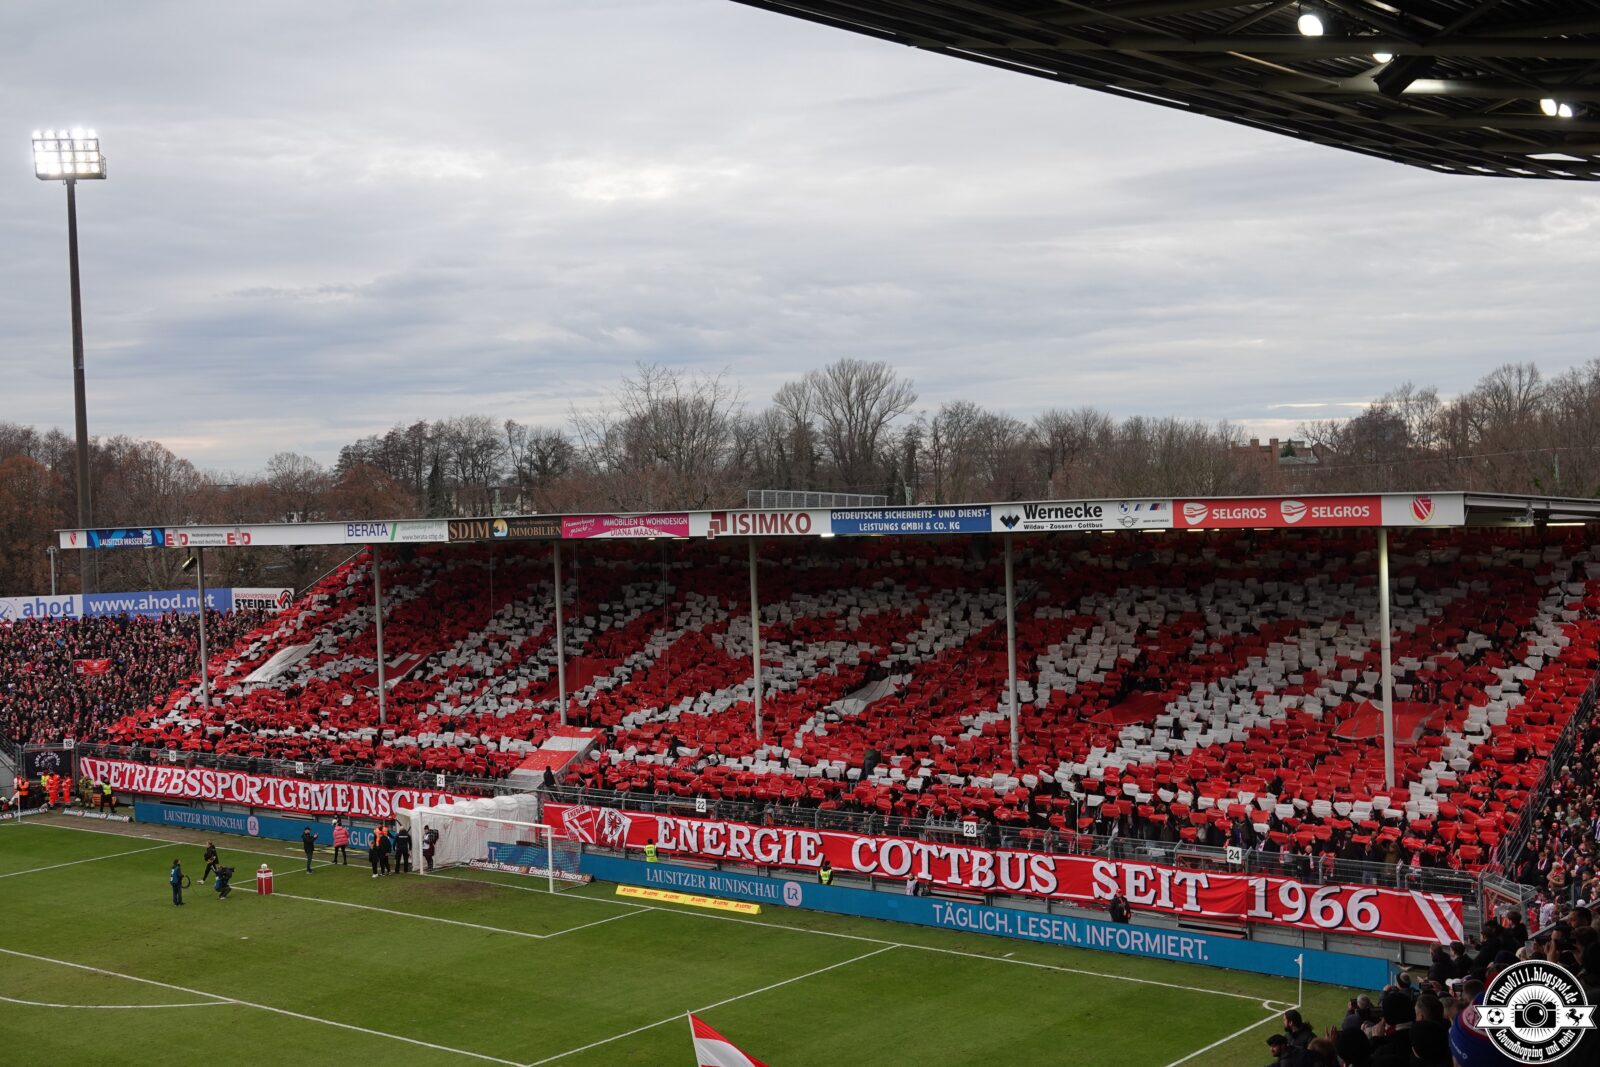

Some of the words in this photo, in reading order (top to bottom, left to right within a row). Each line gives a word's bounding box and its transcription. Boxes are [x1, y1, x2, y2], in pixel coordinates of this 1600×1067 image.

[832, 511, 883, 520] OSTDEUTSCHE
[884, 509, 936, 519] SICHERHEITS-
[938, 509, 954, 518] UND
[958, 508, 990, 518] DIENST-
[1023, 503, 1103, 520] Wernecke
[1212, 507, 1267, 520] SELGROS
[1311, 505, 1370, 518] SELGROS
[603, 517, 638, 526] IMMOBILIEN
[640, 517, 645, 525] &
[646, 516, 688, 526] WOHNDESIGN
[732, 512, 812, 534] ISIMKO
[859, 522, 899, 531] LEISTUNGS
[901, 522, 923, 531] GMBH
[926, 522, 931, 530] &
[934, 522, 947, 530] CO.
[949, 521, 960, 530] KG
[347, 523, 388, 537] BERATA
[450, 522, 490, 540] SDIM
[509, 527, 562, 537] IMMOBILIEN
[610, 527, 632, 536] DIANA
[633, 526, 662, 536] MAASCH
[99, 538, 124, 546] LAUSITZER
[22, 596, 75, 617] ahod
[235, 599, 278, 609] STEIDEL
[95, 760, 468, 818] BETRIEBSSPORTGEMEINSCH
[164, 810, 201, 825] LAUSITZER
[964, 824, 975, 835] 23
[1228, 850, 1240, 861] 24
[528, 866, 559, 877] Eisenbch
[655, 816, 824, 867] ENERGIE
[851, 837, 1058, 894] COTTBUS
[1092, 860, 1209, 912] SEIT
[1247, 877, 1381, 932] 1966
[646, 868, 706, 889] LAUSITZER
[709, 876, 780, 899] RUNDSCHAU
[932, 901, 1012, 933] TÄGLICH.
[1018, 915, 1081, 943] LESEN.
[1086, 925, 1208, 961] INFORMIERT.
